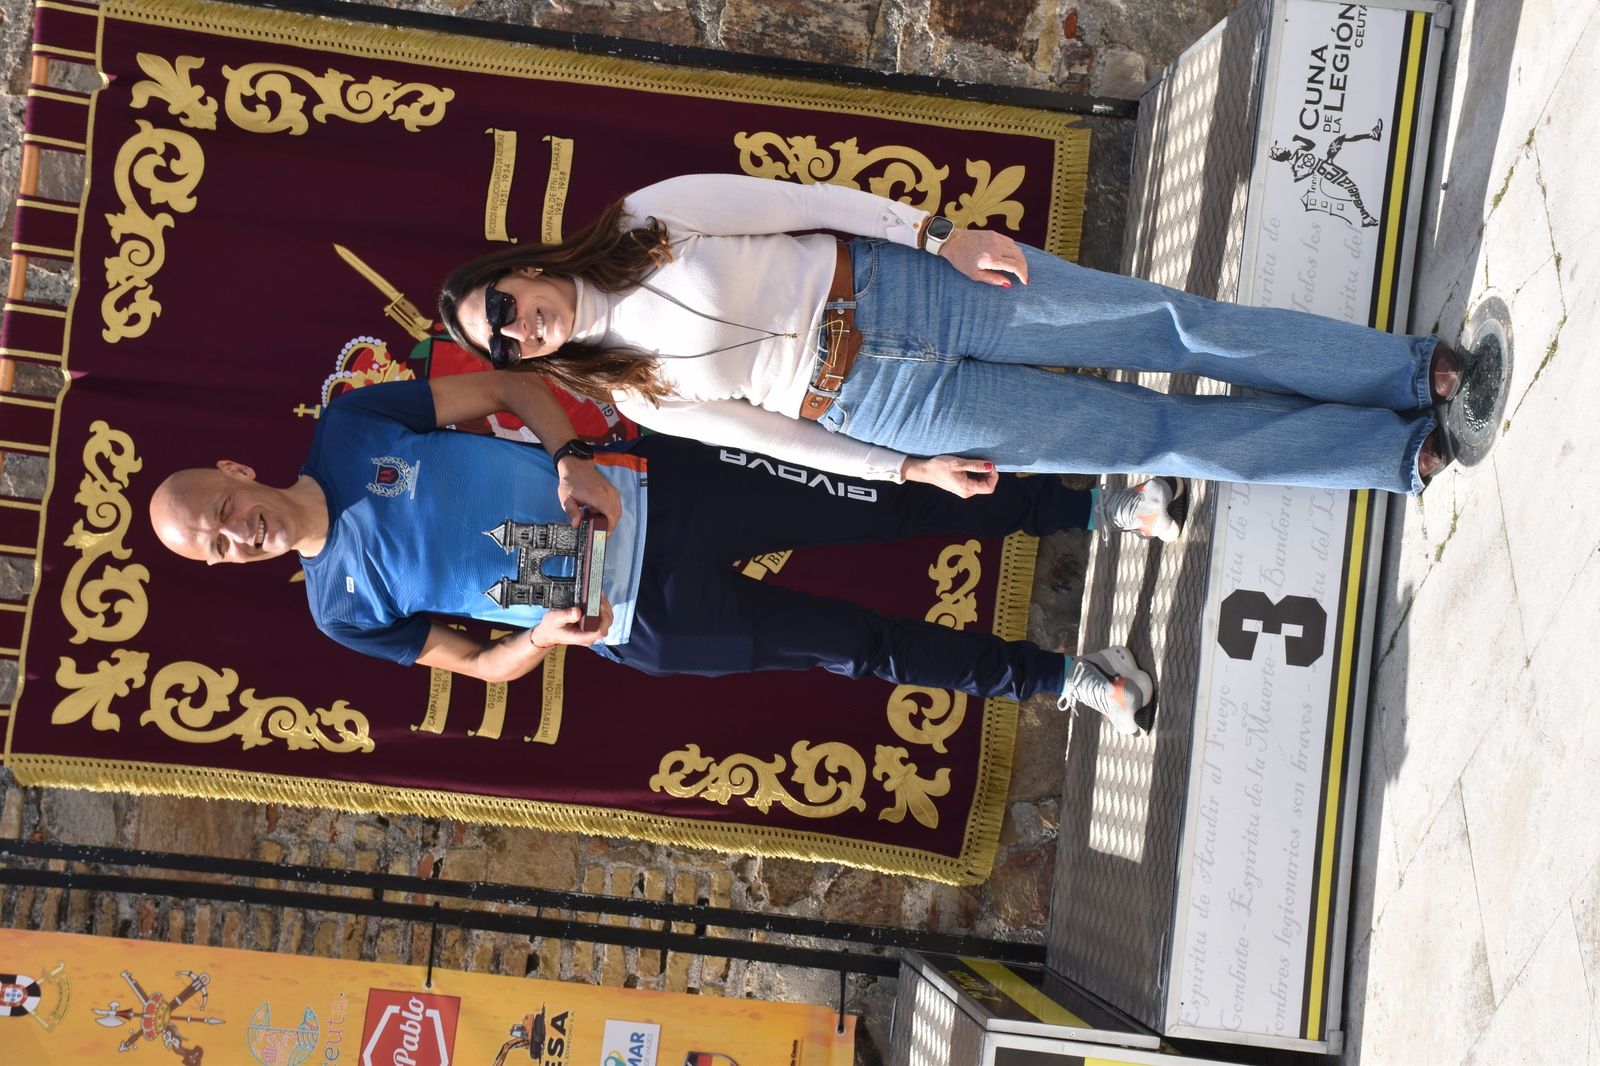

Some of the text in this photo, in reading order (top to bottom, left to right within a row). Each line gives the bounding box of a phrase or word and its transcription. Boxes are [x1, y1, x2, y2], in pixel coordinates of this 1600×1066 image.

[1322, 114, 1333, 133] DE
[1332, 117, 1342, 134] LA
[552, 142, 561, 171] SAHARA
[502, 164, 510, 182] 1934
[550, 177, 558, 192] IFNI
[500, 190, 508, 206] 1931
[548, 193, 556, 203] DE
[554, 196, 562, 216] 1957
[544, 204, 556, 242] CAMPAÑA
[1262, 217, 1280, 242] de
[1300, 222, 1322, 254] los
[720, 449, 878, 502] GIVOVA
[1229, 516, 1248, 540] de
[1311, 523, 1330, 562] del
[1258, 496, 1290, 597] Bandera
[1217, 589, 1328, 667] 3
[547, 668, 556, 679] EN
[542, 680, 554, 738] INTERVENCIÓN
[1204, 684, 1238, 752] Fuego
[1241, 656, 1276, 752] Muerte
[1290, 702, 1313, 774] bravos
[1202, 759, 1222, 784] al
[1245, 758, 1266, 780] la
[1244, 783, 1263, 808] de
[1292, 780, 1306, 818] son
[1192, 794, 1220, 883] Acudir
[1272, 826, 1302, 948] legionarios
[1192, 894, 1210, 919] de
[393, 996, 424, 1066] Pablo
